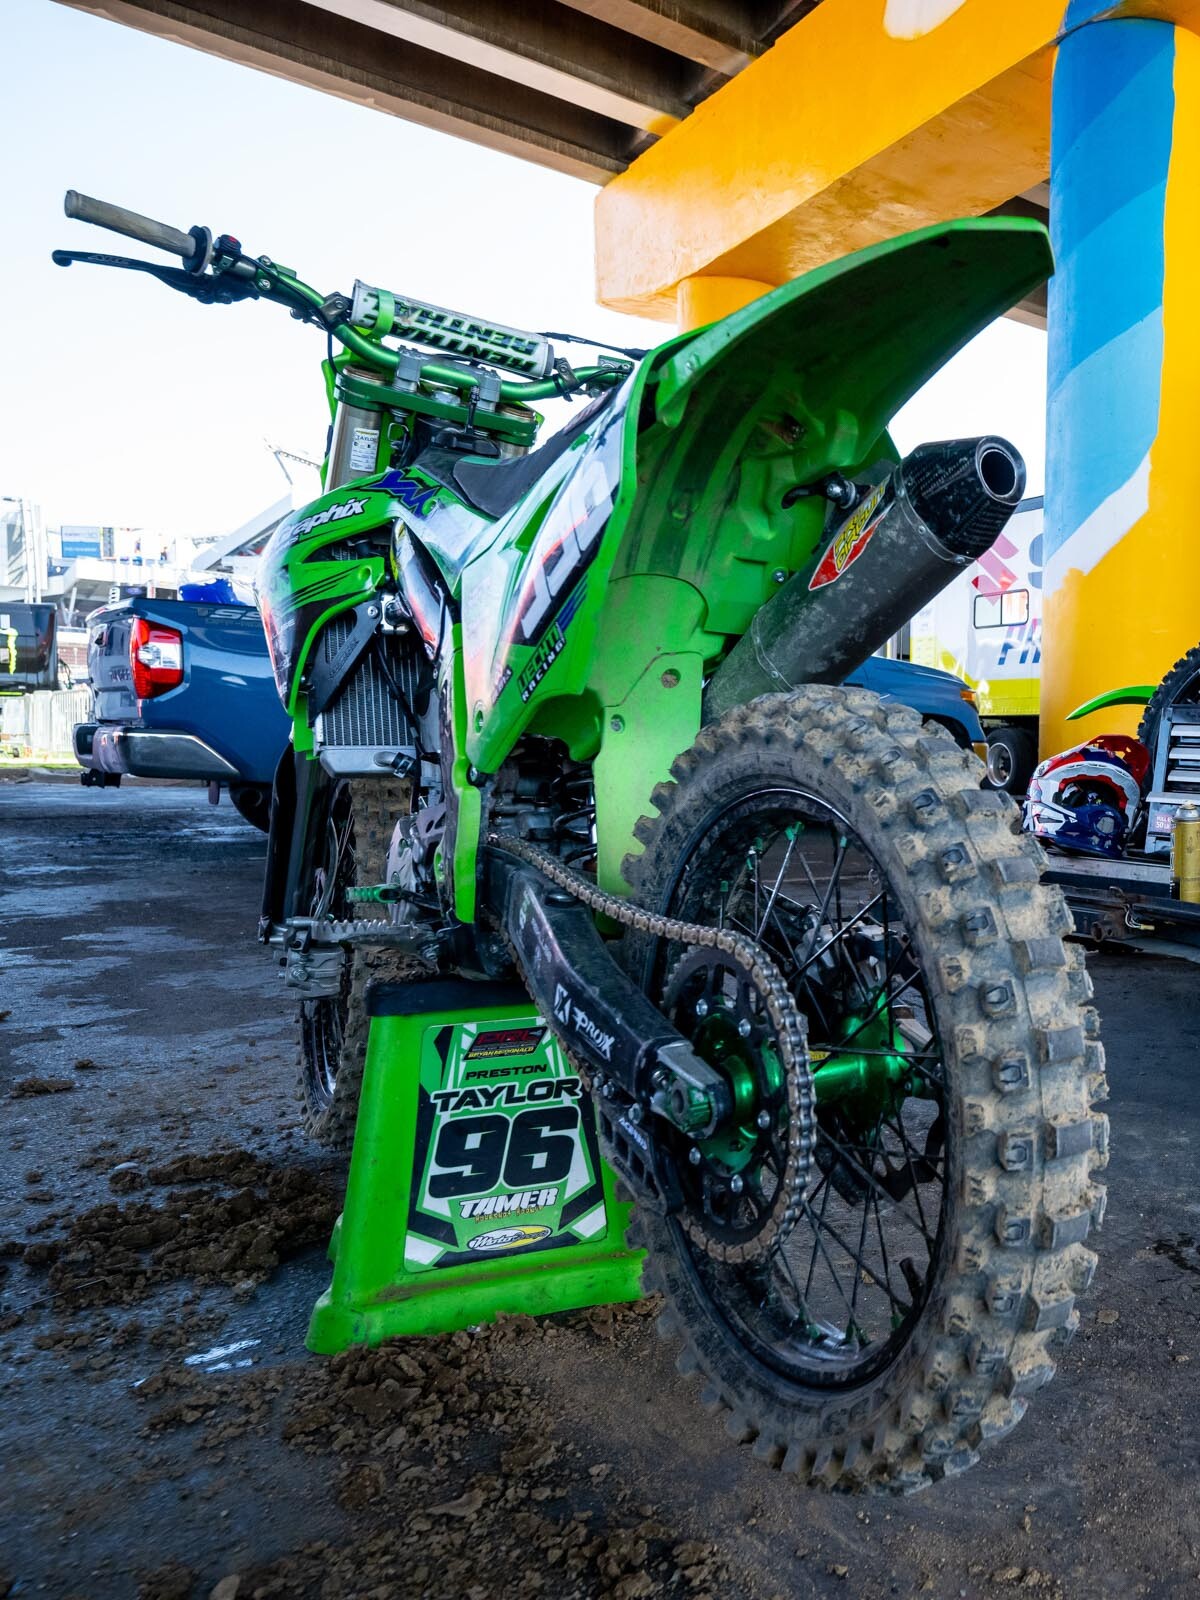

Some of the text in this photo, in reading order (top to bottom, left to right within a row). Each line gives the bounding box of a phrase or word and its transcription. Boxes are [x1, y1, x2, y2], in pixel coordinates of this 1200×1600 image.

[521, 638, 566, 703] RACING
[465, 1063, 548, 1080] PRESTON
[431, 1076, 583, 1114] TAYLOR
[428, 1105, 581, 1199] 96
[459, 1187, 559, 1219] TAMER
